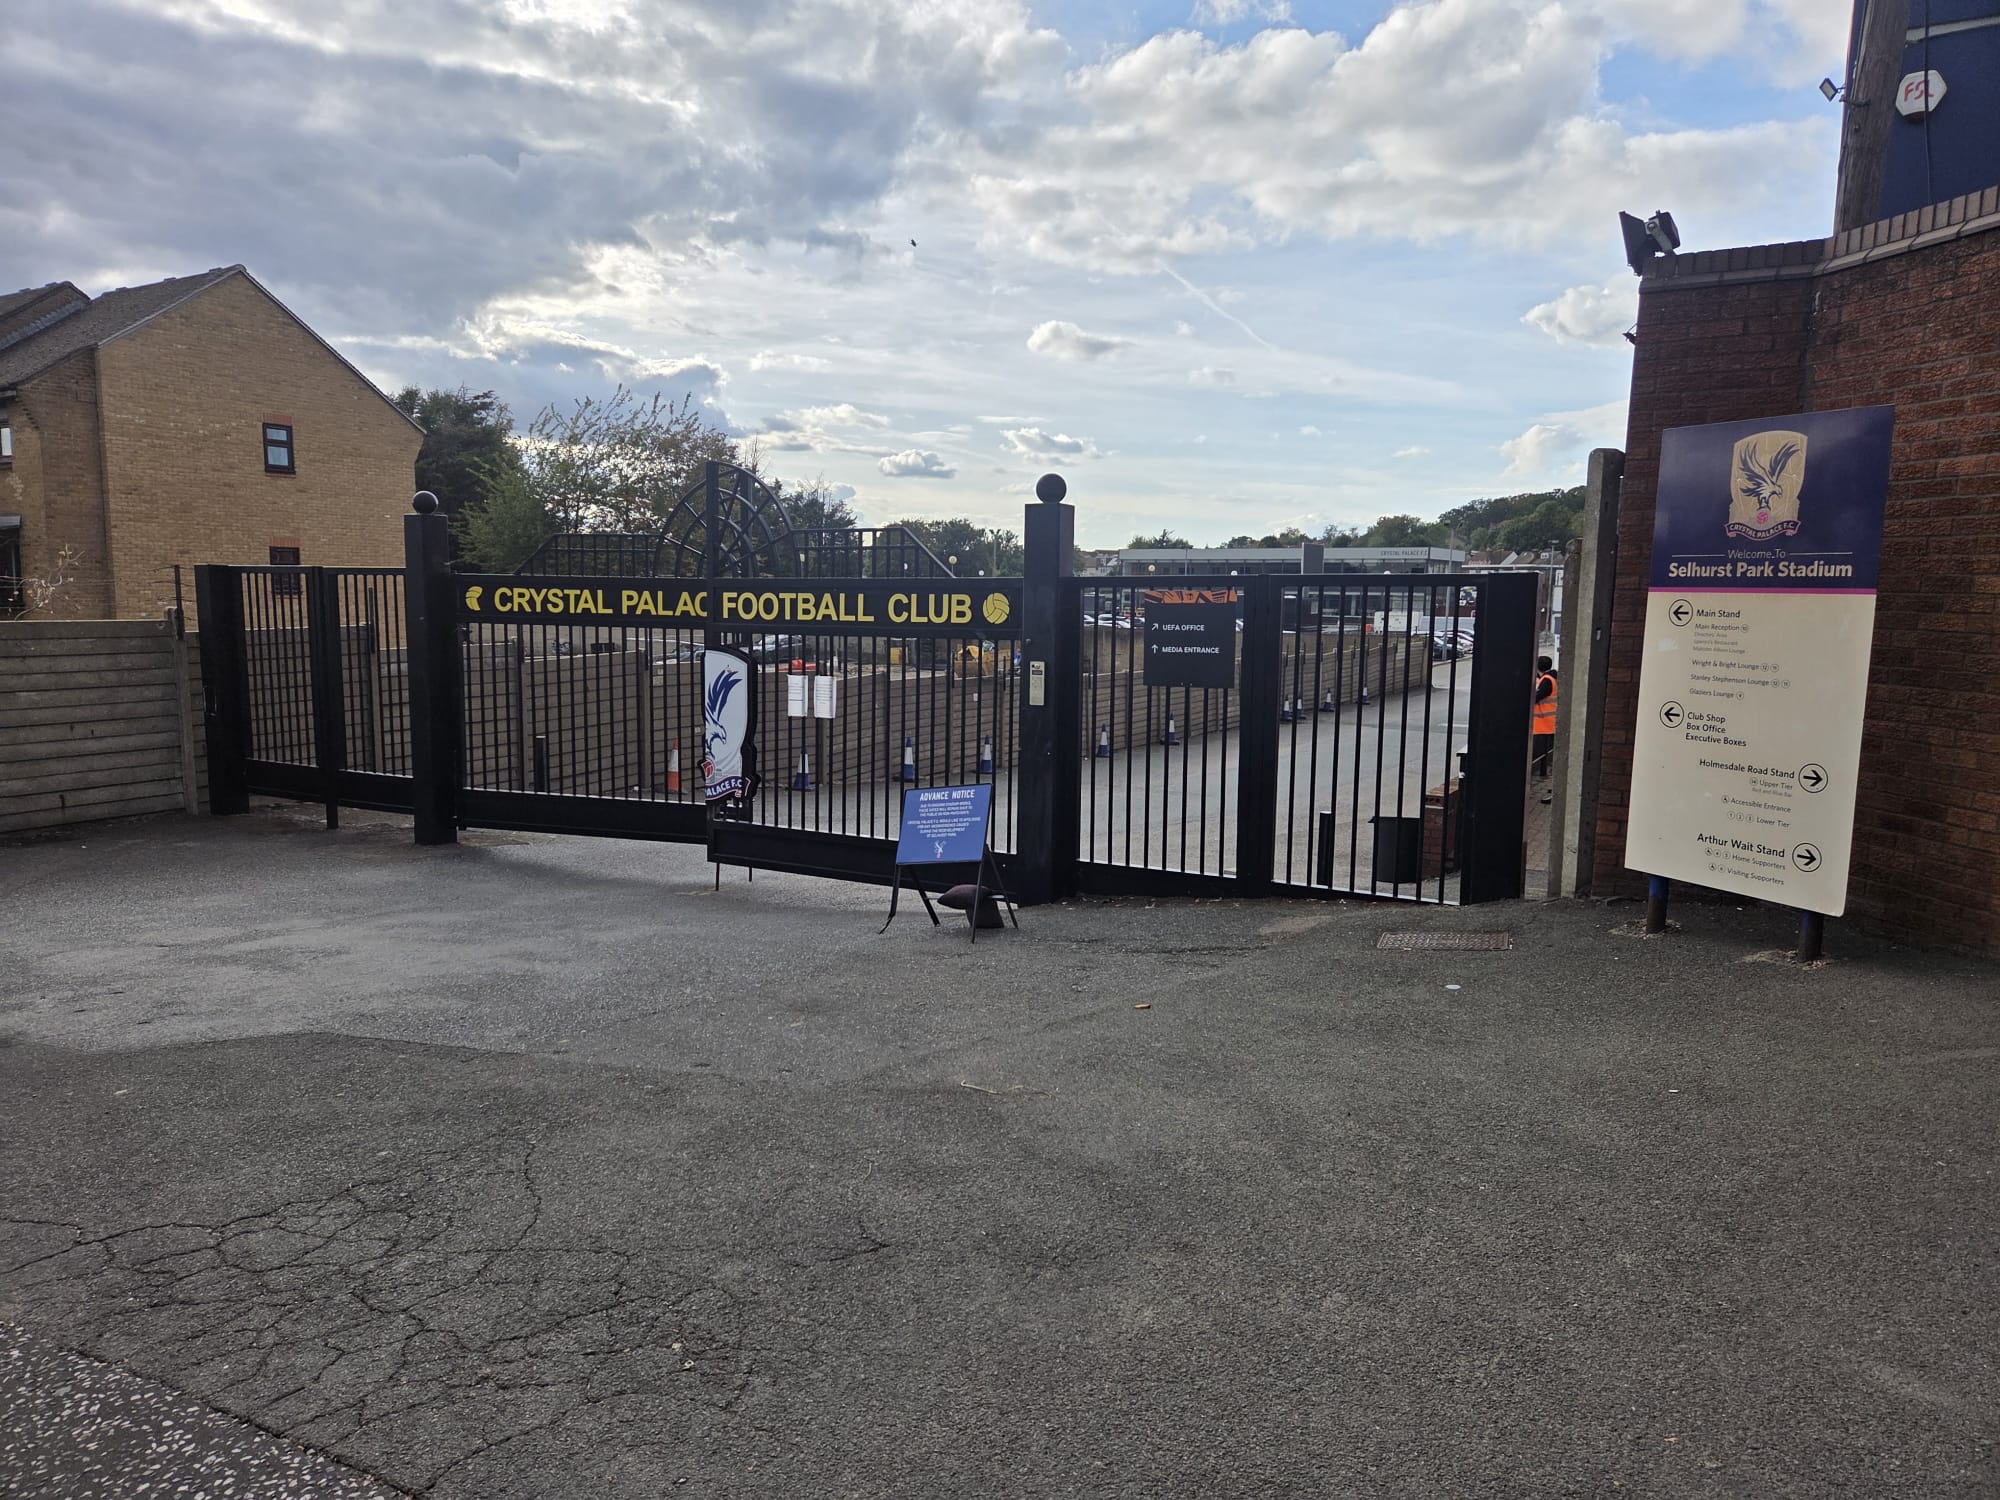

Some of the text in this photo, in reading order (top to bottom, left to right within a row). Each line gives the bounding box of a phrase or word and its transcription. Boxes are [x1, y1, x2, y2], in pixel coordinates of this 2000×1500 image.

[1729, 523, 1756, 538] CRYSTAL
[1756, 525, 1783, 538] PALACE
[1727, 548, 1786, 559] Welcome To
[1668, 560, 1853, 578] Selhurst Park Stadium
[494, 586, 972, 624] CRYSTAL PALAC FOOTBALL CLUB
[1696, 609, 1741, 619] Main Stand
[1181, 624, 1205, 632] OFFICE
[1184, 646, 1220, 654] ENTRANCE
[1737, 662, 1760, 670] Lounge
[1747, 678, 1770, 686] Lounge
[1713, 690, 1734, 698] Lounge
[1687, 711, 1726, 724] Club Shop
[1686, 723, 1726, 734] Box Office
[1685, 733, 1747, 747] Executive Boxes
[1699, 758, 1795, 780] Holmesdale Road Stand
[705, 780, 730, 797] ALACE
[1759, 780, 1779, 788] Upper
[1780, 782, 1793, 790] Tier
[919, 789, 976, 801] ADVANCE NOTICE
[1730, 797, 1792, 813] Accessible Entrance
[1756, 815, 1776, 825] Lower
[1777, 820, 1790, 828] Tier
[1696, 833, 1786, 858] Arthur Wait Stand
[1732, 853, 1751, 863] Home
[1752, 857, 1786, 871] Supporters
[1727, 867, 1785, 885] Visiting Supporters
